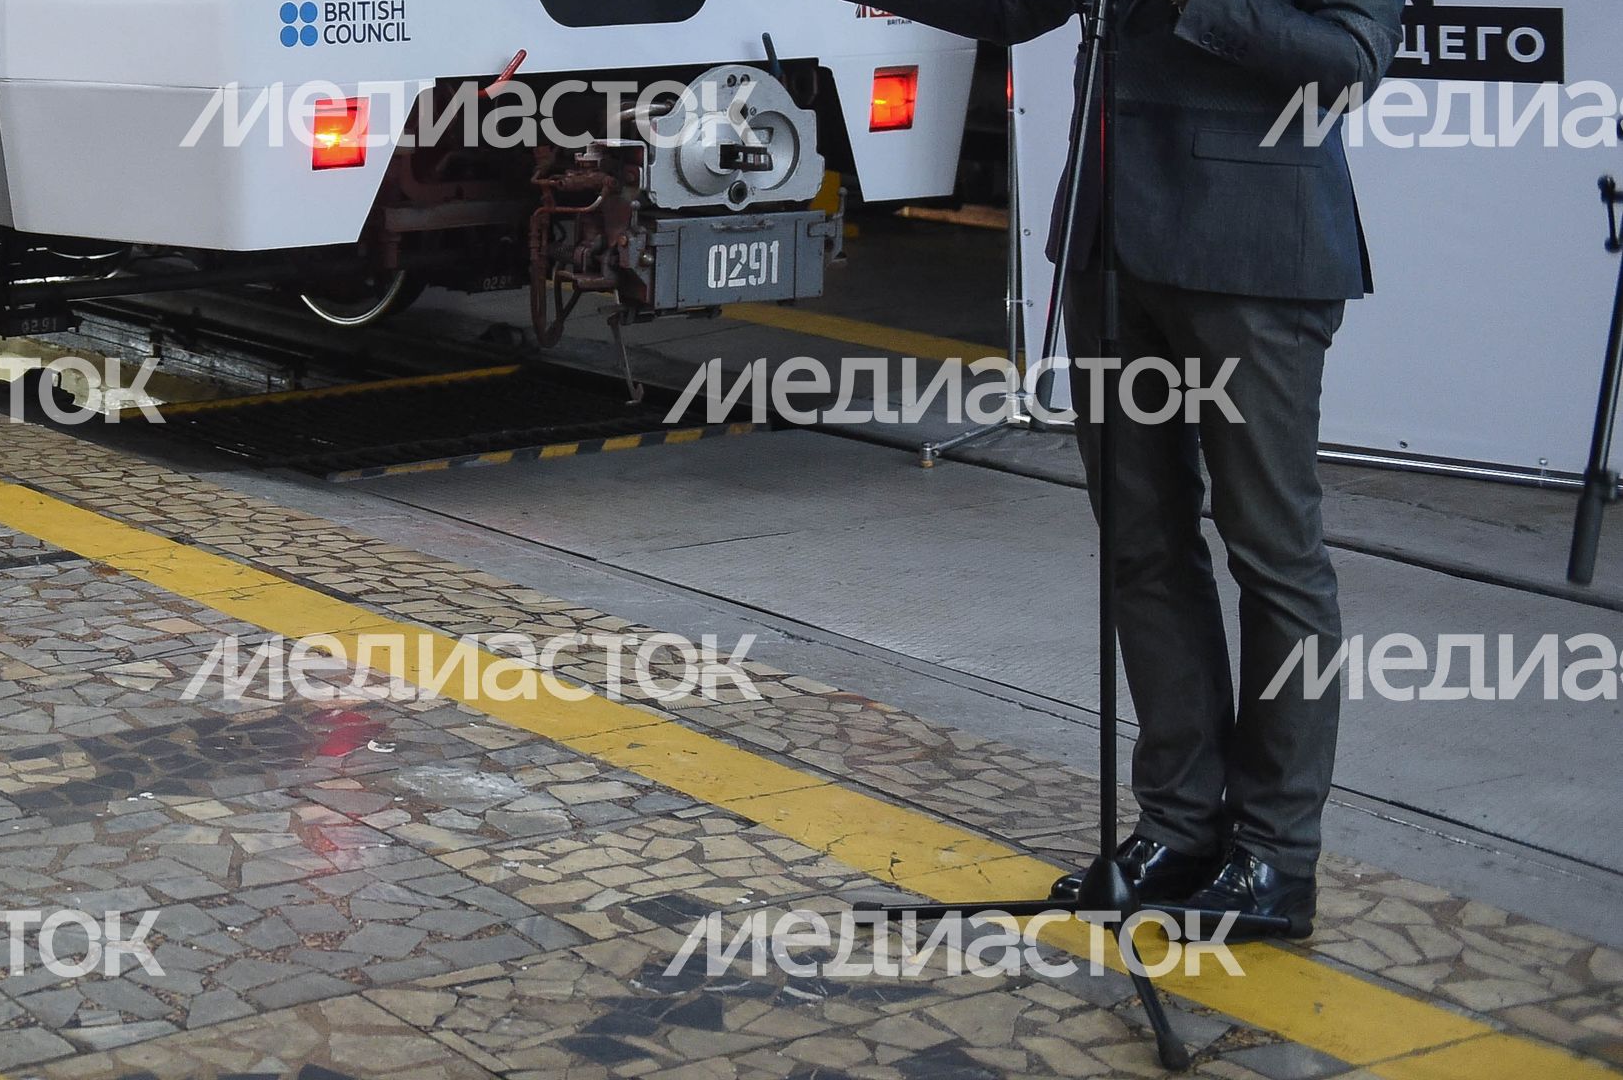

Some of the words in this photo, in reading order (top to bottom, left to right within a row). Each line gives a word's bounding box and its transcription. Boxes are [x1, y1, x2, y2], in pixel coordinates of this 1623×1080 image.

[324, 0, 405, 22] BRITISH
[323, 22, 411, 45] COUNCIL
[1394, 24, 1546, 66] ЩЕГО
[707, 240, 780, 289] 0291
